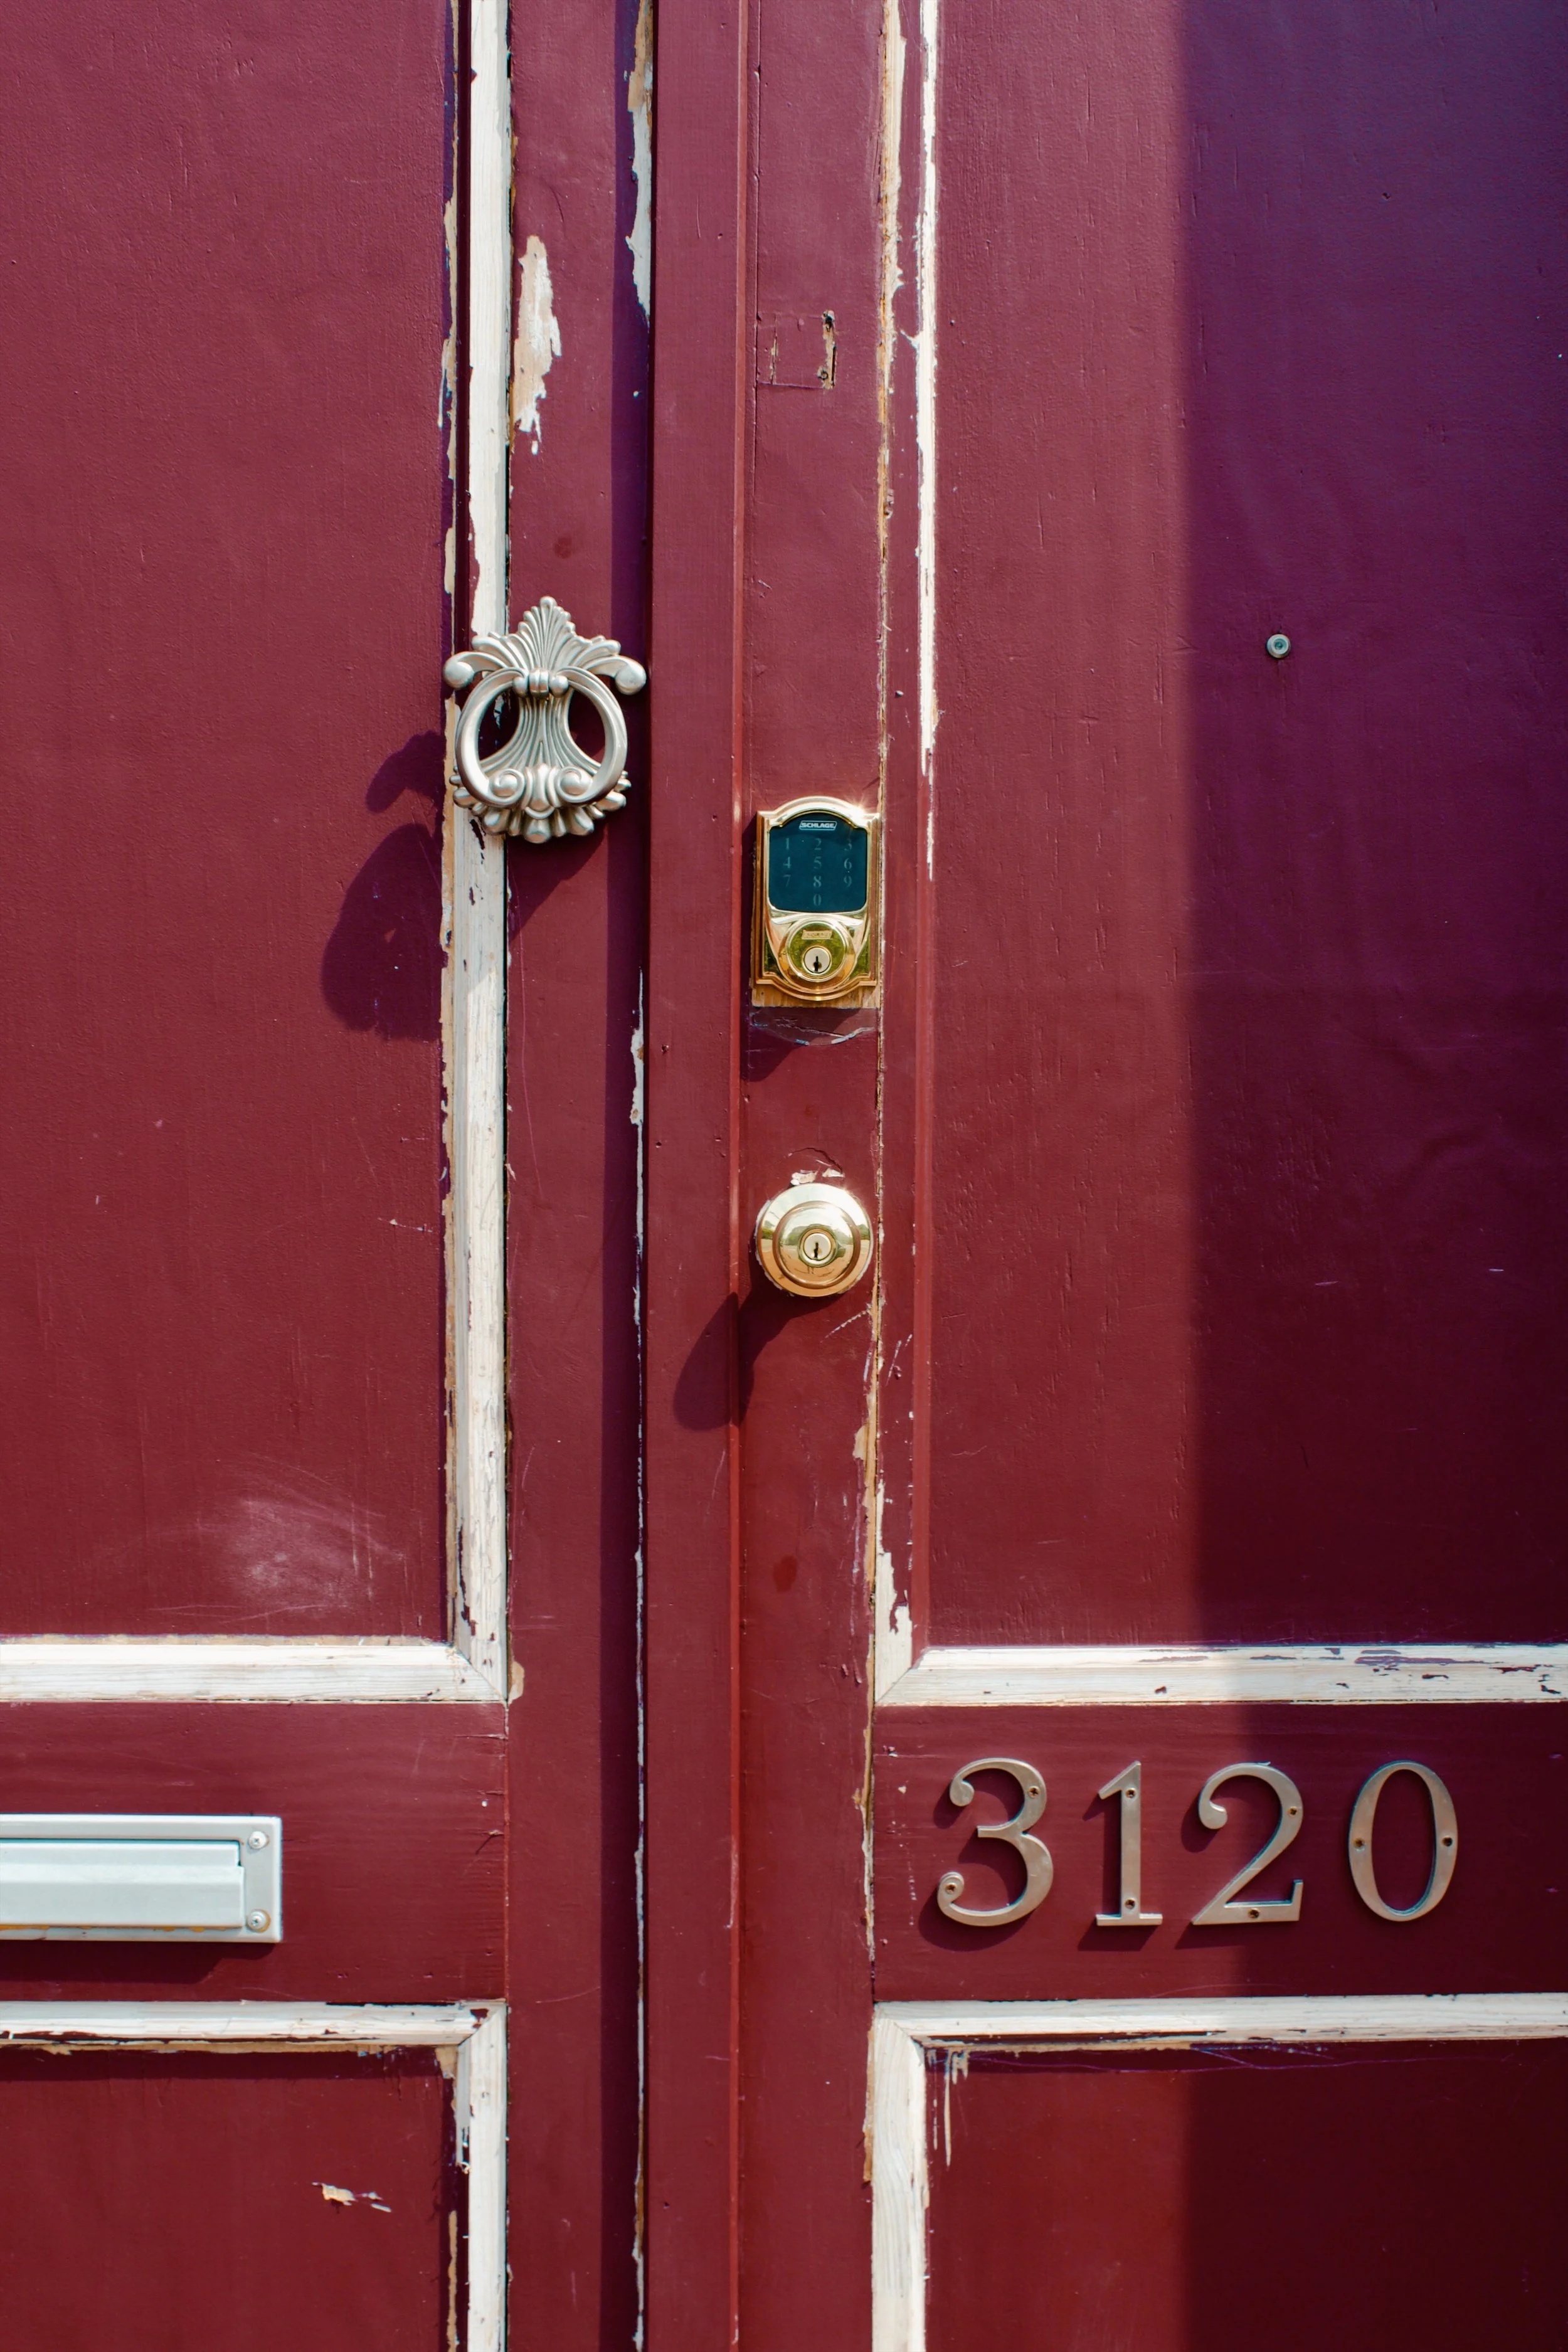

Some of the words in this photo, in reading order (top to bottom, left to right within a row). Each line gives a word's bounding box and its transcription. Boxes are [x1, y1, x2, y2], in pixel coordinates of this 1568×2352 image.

[785, 837, 790, 850] 1
[814, 837, 822, 851] 2
[844, 838, 852, 852] 3
[782, 856, 792, 869] 4
[813, 856, 822, 869] 5
[844, 857, 852, 870] 6
[783, 874, 791, 887] 7
[813, 876, 822, 888] 8
[844, 876, 852, 888] 9
[813, 894, 822, 906] 0
[937, 1757, 1458, 1926] 3120
